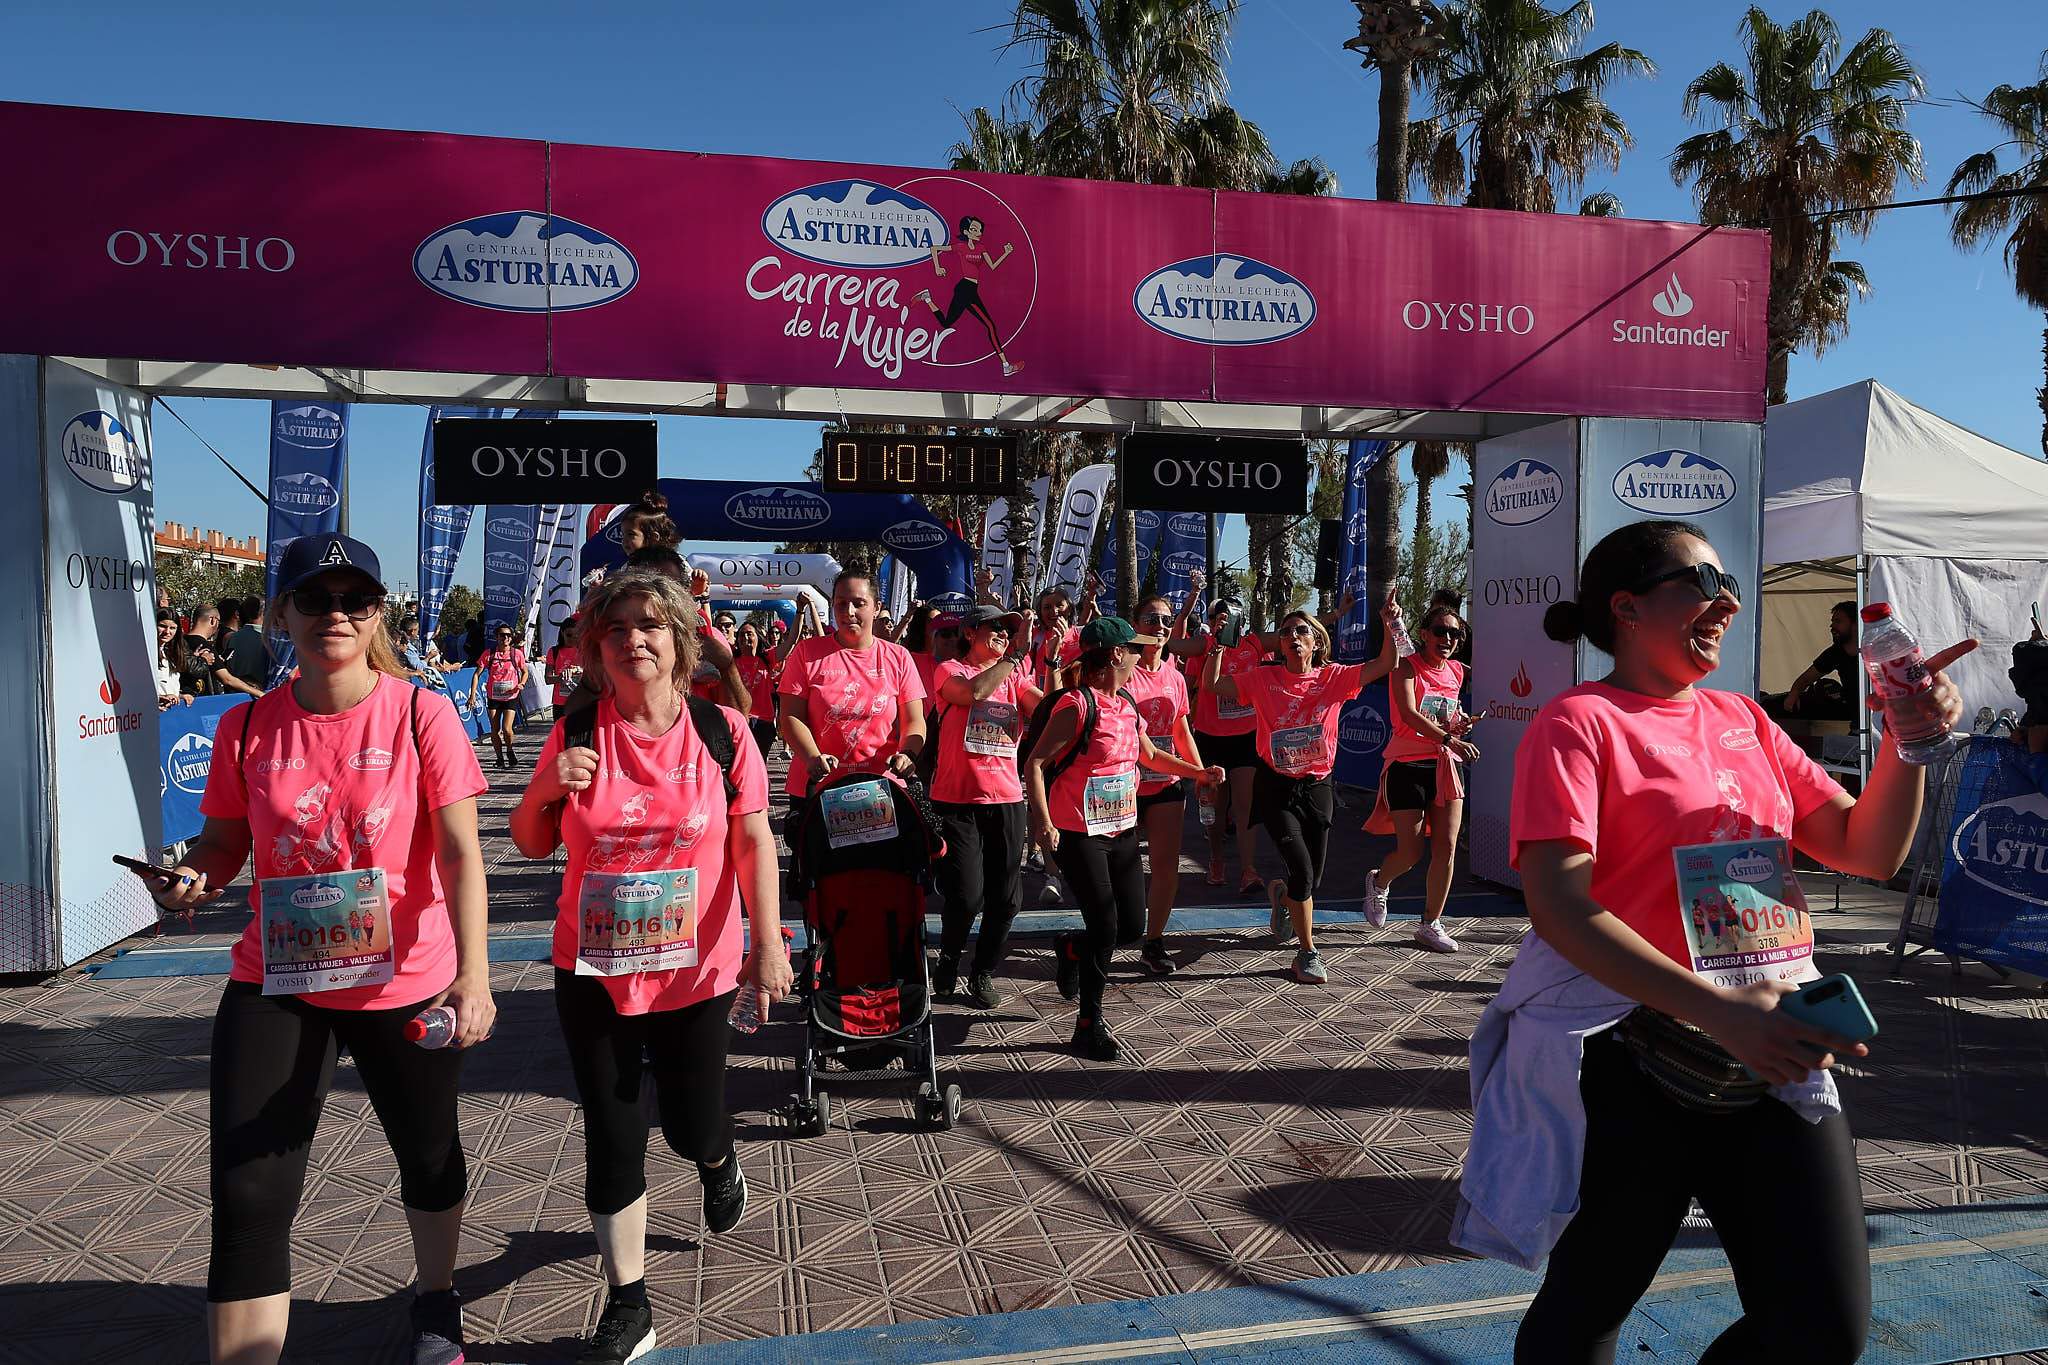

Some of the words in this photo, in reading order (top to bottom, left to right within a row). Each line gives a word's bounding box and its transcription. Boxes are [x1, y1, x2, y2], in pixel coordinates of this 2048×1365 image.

[806, 207, 865, 219] CENTRAL
[871, 211, 930, 224] LECHERA
[777, 207, 933, 249] ASTURIANA
[106, 229, 296, 273] OYSHO
[466, 243, 537, 256] CENTRAL
[543, 247, 616, 259] LECHERA
[431, 244, 622, 288] ASTURIANA
[745, 256, 900, 309] Carrera
[1176, 283, 1233, 294] CENTRAL
[1239, 286, 1297, 297] LECHERA
[1148, 284, 1302, 323] ASTURIANA
[1402, 300, 1535, 335] OYSHO
[783, 306, 813, 337] de
[819, 307, 840, 339] la
[835, 306, 956, 379] Mujer
[1612, 319, 1730, 347] Santander
[68, 432, 138, 478] ASTURIANA
[471, 446, 627, 479] OYSHO
[837, 443, 1003, 482] 01:09:11
[1153, 458, 1282, 490] OYSHO
[1640, 472, 1680, 480] CENTRAL
[1683, 473, 1724, 481] LECHERA
[1621, 473, 1727, 500] ASTURIANA
[1489, 486, 1556, 512] ASTURIANA
[733, 499, 824, 520] ASTURIANA
[887, 526, 943, 543] ASTURIANA
[1171, 517, 1206, 534] ASTURIA
[319, 541, 352, 566] A
[67, 553, 145, 592] OYSHO
[719, 559, 802, 577] OYSHO
[1484, 575, 1561, 606] OYSHO
[1489, 700, 1540, 721] Santand
[79, 709, 143, 739] Santander
[1104, 800, 1125, 810] 016
[848, 809, 874, 822] 016
[293, 893, 341, 905] ASTURIANA
[615, 889, 660, 899] ASTURIANA
[616, 917, 661, 936] 016
[1741, 904, 1785, 933] 016
[297, 925, 347, 947] 016
[629, 938, 646, 946] 493
[1758, 937, 1779, 950] 3788
[312, 949, 331, 959] 494
[585, 948, 613, 957] CARRERA
[613, 949, 624, 957] DE
[624, 948, 633, 956] LA
[634, 945, 656, 955] MUJER
[660, 941, 689, 952] VALENCIA
[1701, 956, 1743, 968] CARRERA
[1745, 955, 1756, 964] DE
[1758, 953, 1768, 962] LA
[1769, 950, 1788, 961] MUJER
[270, 964, 298, 973] CARRERA
[298, 963, 307, 971] DE
[308, 962, 318, 970] LA
[319, 960, 344, 969] MUJER
[350, 953, 385, 965] VALENCIA
[590, 960, 627, 970] OYSHO
[649, 955, 685, 966] Santander
[277, 976, 313, 987] OYSHO
[339, 970, 380, 981] Santander
[1714, 972, 1765, 987] OYSHO
